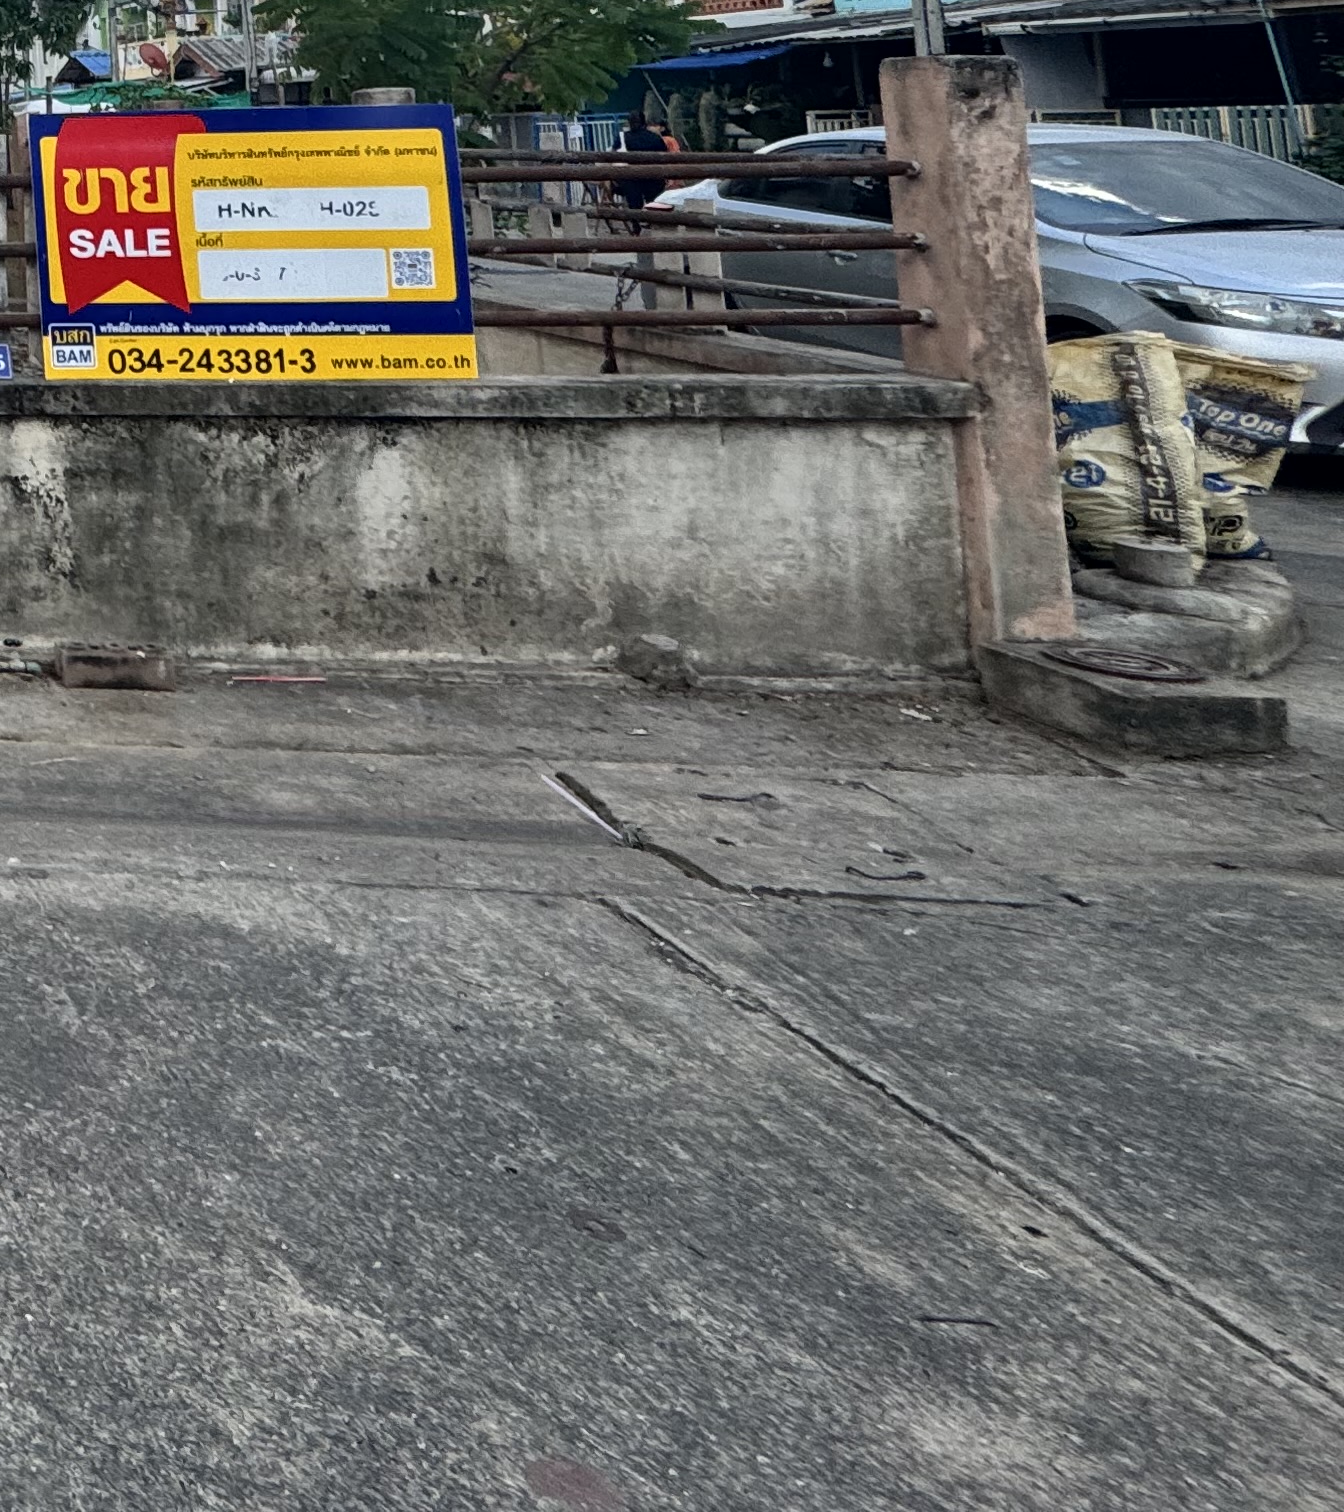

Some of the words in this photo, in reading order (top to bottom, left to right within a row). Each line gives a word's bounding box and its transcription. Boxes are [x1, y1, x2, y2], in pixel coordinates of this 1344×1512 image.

[363, 146, 392, 158] จำกัด
[394, 146, 438, 158] (มหาชน)
[62, 166, 172, 215] ขาย
[191, 176, 264, 188] รหัสทรัพย์สิน
[68, 228, 173, 259] SALE
[195, 233, 224, 248] เนื้อที่
[54, 326, 92, 345] บสก
[55, 345, 93, 364] BAM
[108, 347, 317, 375] 034-243381-3
[331, 354, 471, 370] www.bam.co.th
